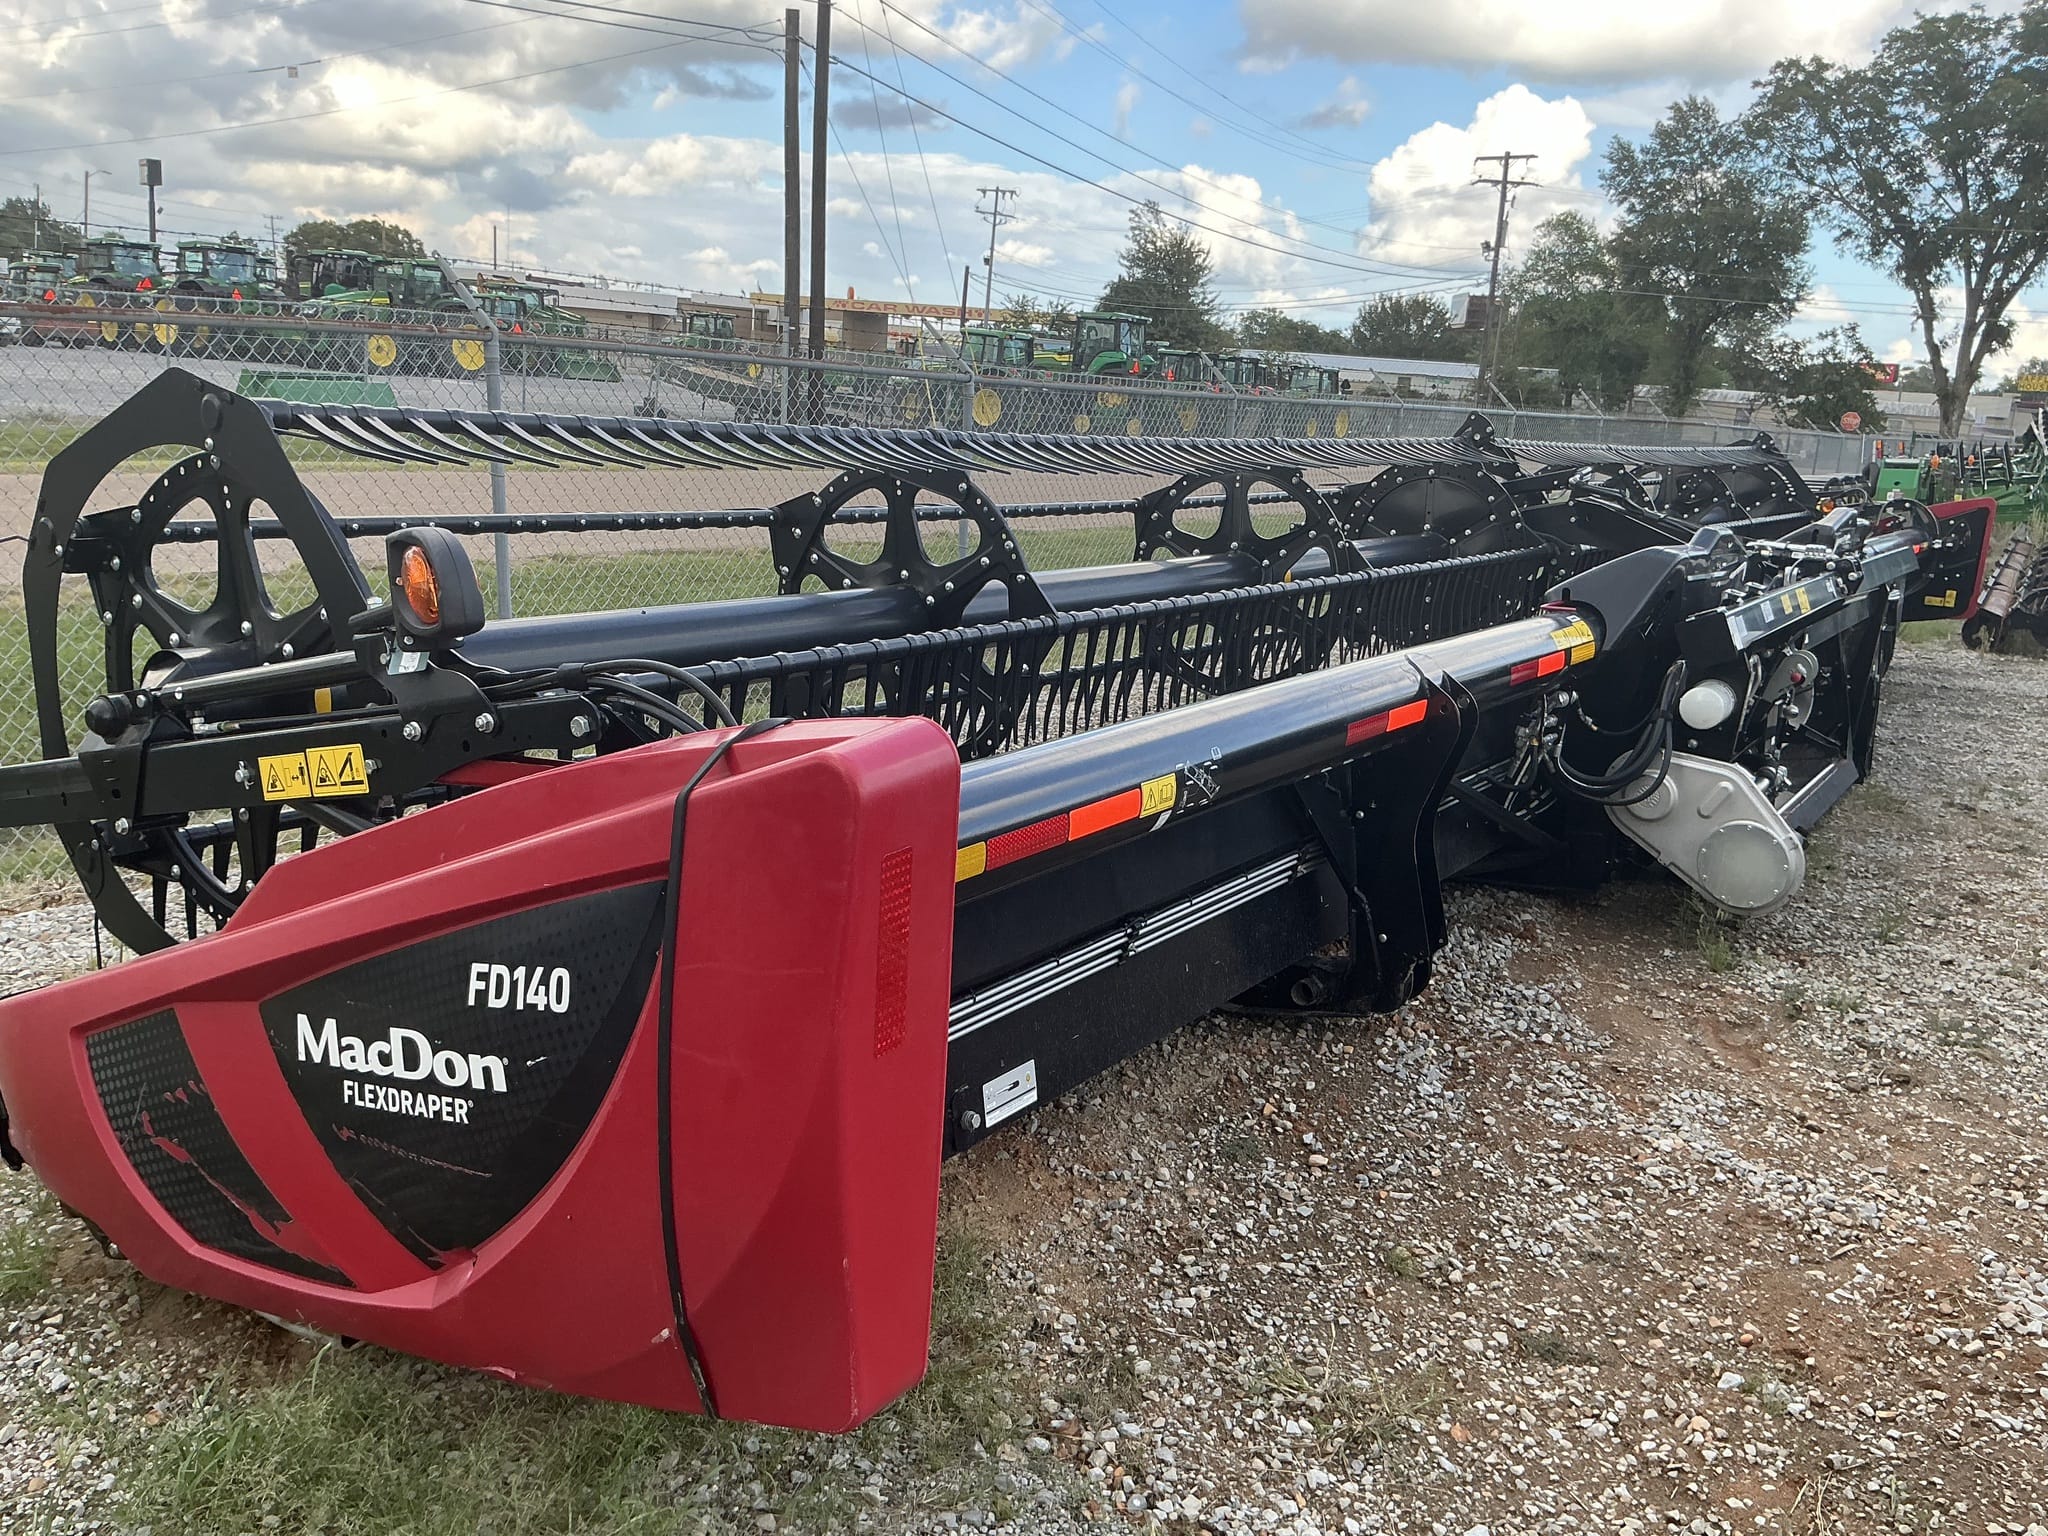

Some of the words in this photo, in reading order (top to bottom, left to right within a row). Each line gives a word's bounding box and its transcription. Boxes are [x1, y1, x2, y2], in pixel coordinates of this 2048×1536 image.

[851, 301, 897, 312] CAR
[905, 304, 972, 318] WASH
[468, 962, 571, 1014] FD140
[297, 1013, 508, 1093] MacDon
[343, 1079, 470, 1124] FLEXDRAPER
